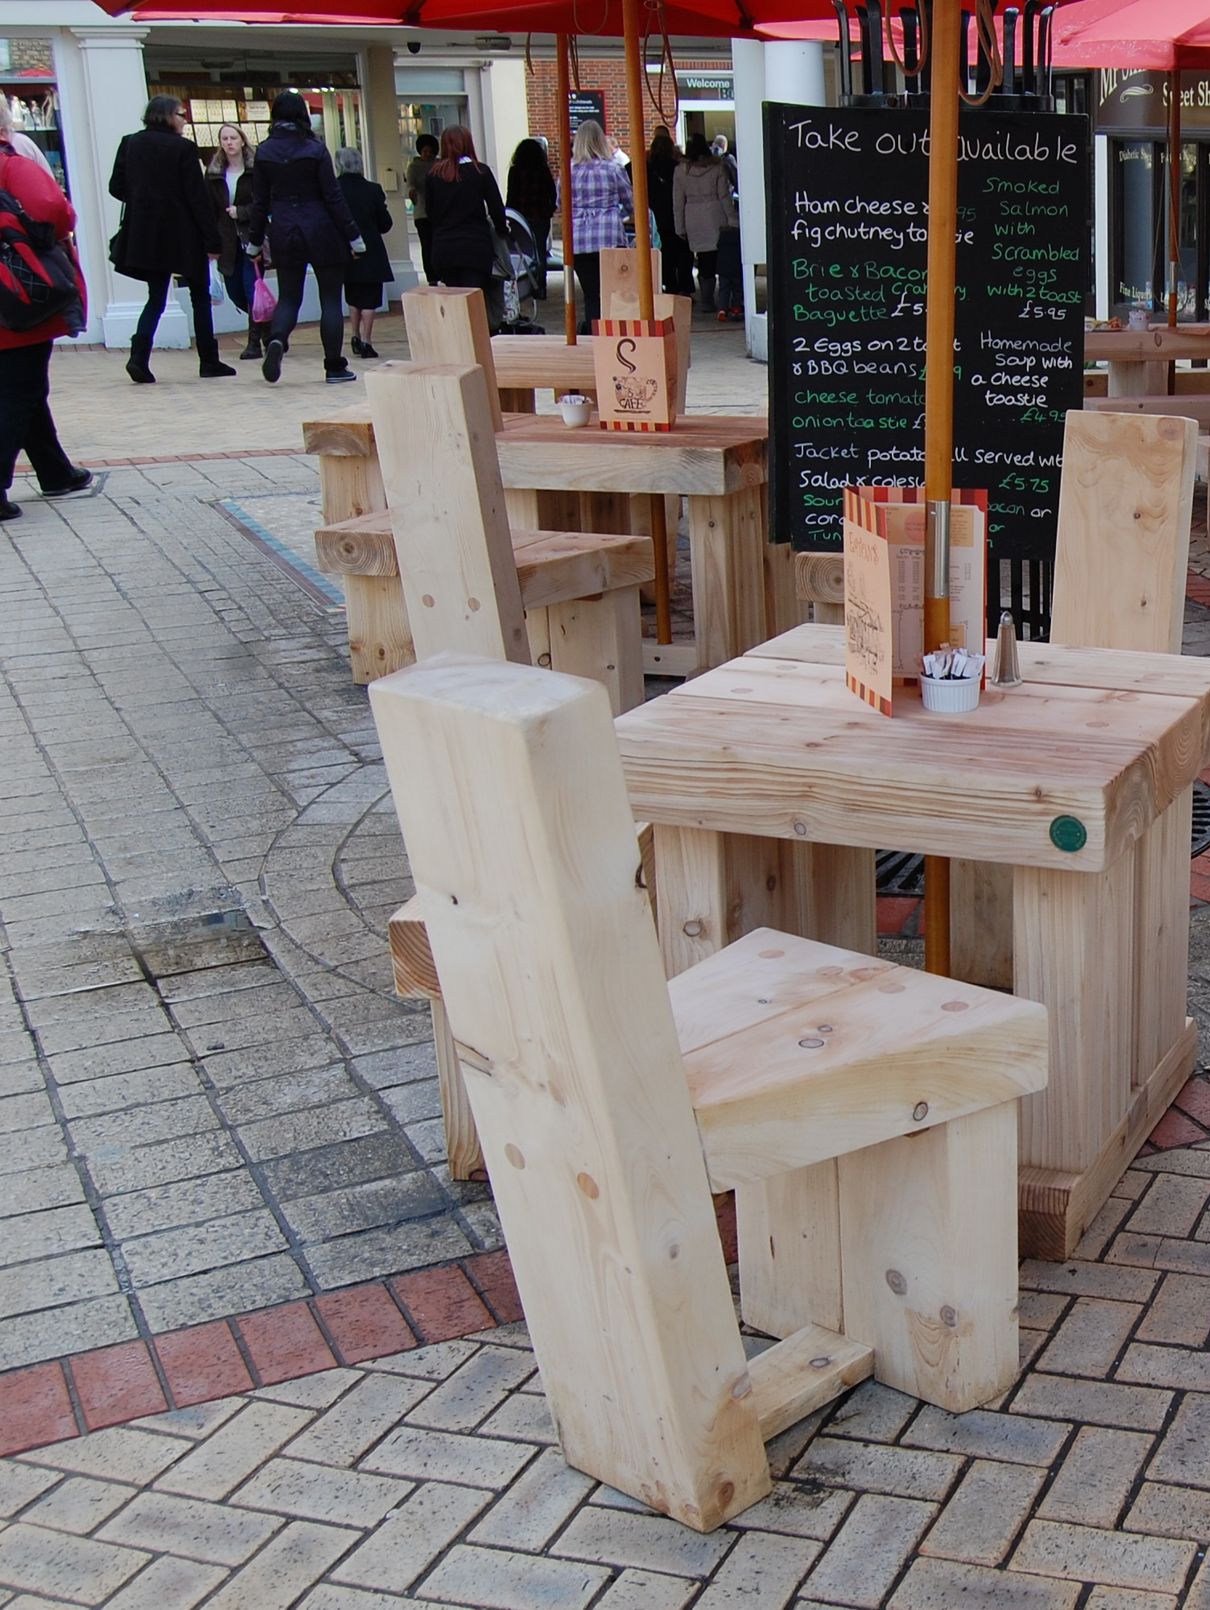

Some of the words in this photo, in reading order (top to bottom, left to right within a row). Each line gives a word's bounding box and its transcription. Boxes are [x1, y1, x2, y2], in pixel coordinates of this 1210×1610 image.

[686, 78, 730, 89] Welcome
[1163, 81, 1195, 107] Seet
[788, 119, 862, 151] Take
[875, 128, 931, 156] out
[956, 131, 1078, 164] available
[982, 176, 1060, 195] Smoked
[795, 190, 841, 214] Ham
[844, 195, 919, 215] cheese
[999, 200, 1069, 217] Salmon
[791, 218, 823, 248] fig
[824, 222, 905, 249] chutney
[994, 221, 1036, 236] with
[991, 242, 1080, 262] Scrambled
[792, 258, 844, 280] Brie
[1012, 265, 1057, 285] eggs
[805, 282, 886, 303] toasted
[986, 282, 1024, 298] with
[1025, 286, 1037, 298] 2
[1038, 285, 1083, 305] toast
[793, 303, 890, 327] Baguette
[1017, 299, 1068, 321] £5.95
[792, 337, 810, 352] 2
[813, 337, 862, 357] Eggs
[867, 340, 894, 352] on
[898, 336, 911, 351] 2
[980, 330, 1073, 353] Homemade
[807, 359, 849, 375] BBQ
[853, 359, 918, 377] beans
[995, 353, 1037, 372] Soup
[1041, 355, 1073, 370] with
[970, 373, 987, 386] a
[794, 389, 859, 405] cheese
[984, 389, 1049, 408] toastie
[792, 415, 845, 429] onion
[846, 412, 907, 430] toastie
[794, 442, 860, 459] Jacket
[974, 449, 1036, 467] served
[1038, 454, 1065, 467] wit
[799, 470, 850, 489] Salad
[808, 529, 842, 541] Tun
